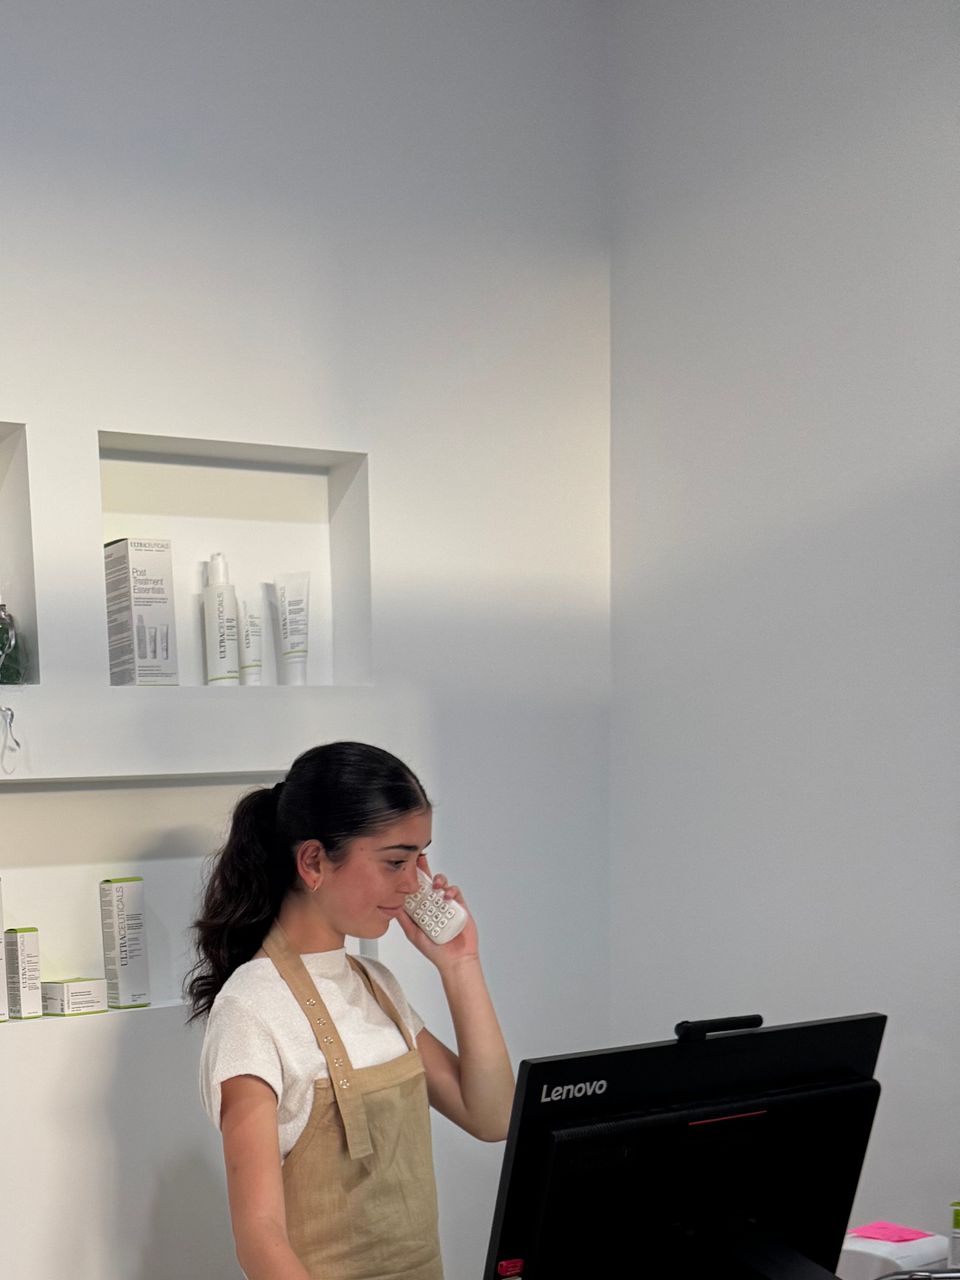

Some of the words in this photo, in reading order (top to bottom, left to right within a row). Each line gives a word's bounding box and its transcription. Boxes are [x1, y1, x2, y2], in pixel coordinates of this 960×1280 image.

[132, 568, 147, 576] Post
[117, 886, 128, 966] ULTRACEUTICALS
[541, 1080, 607, 1103] Lenovo
